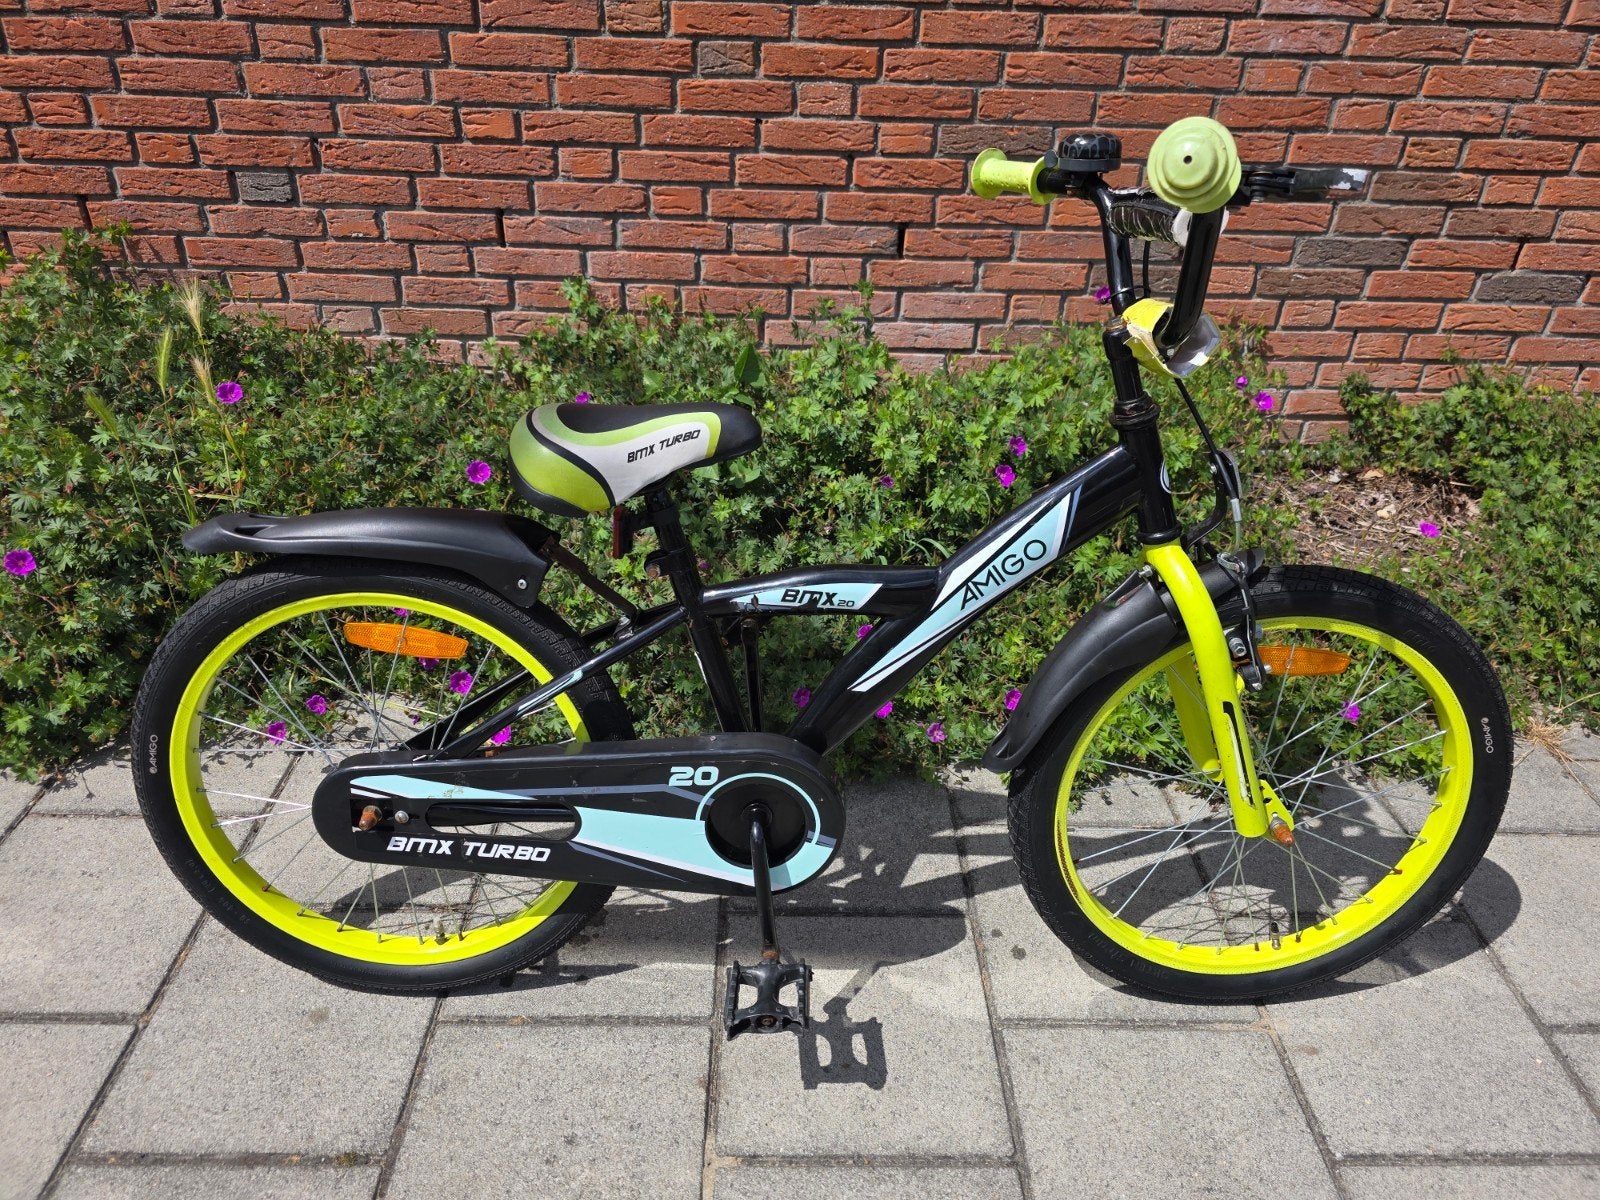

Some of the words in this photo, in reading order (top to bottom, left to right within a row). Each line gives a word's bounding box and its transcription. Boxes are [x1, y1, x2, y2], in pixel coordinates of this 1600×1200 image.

[627, 444, 655, 463] BMX
[659, 429, 701, 450] TURBO
[960, 539, 1047, 611] AMIGO
[781, 588, 838, 606] BMX
[837, 600, 855, 608] 20
[149, 734, 158, 767] AMIGO
[1482, 723, 1494, 753] AMIGO
[668, 766, 719, 787] 20
[386, 836, 454, 855] BMX
[463, 841, 551, 862] TURBO
